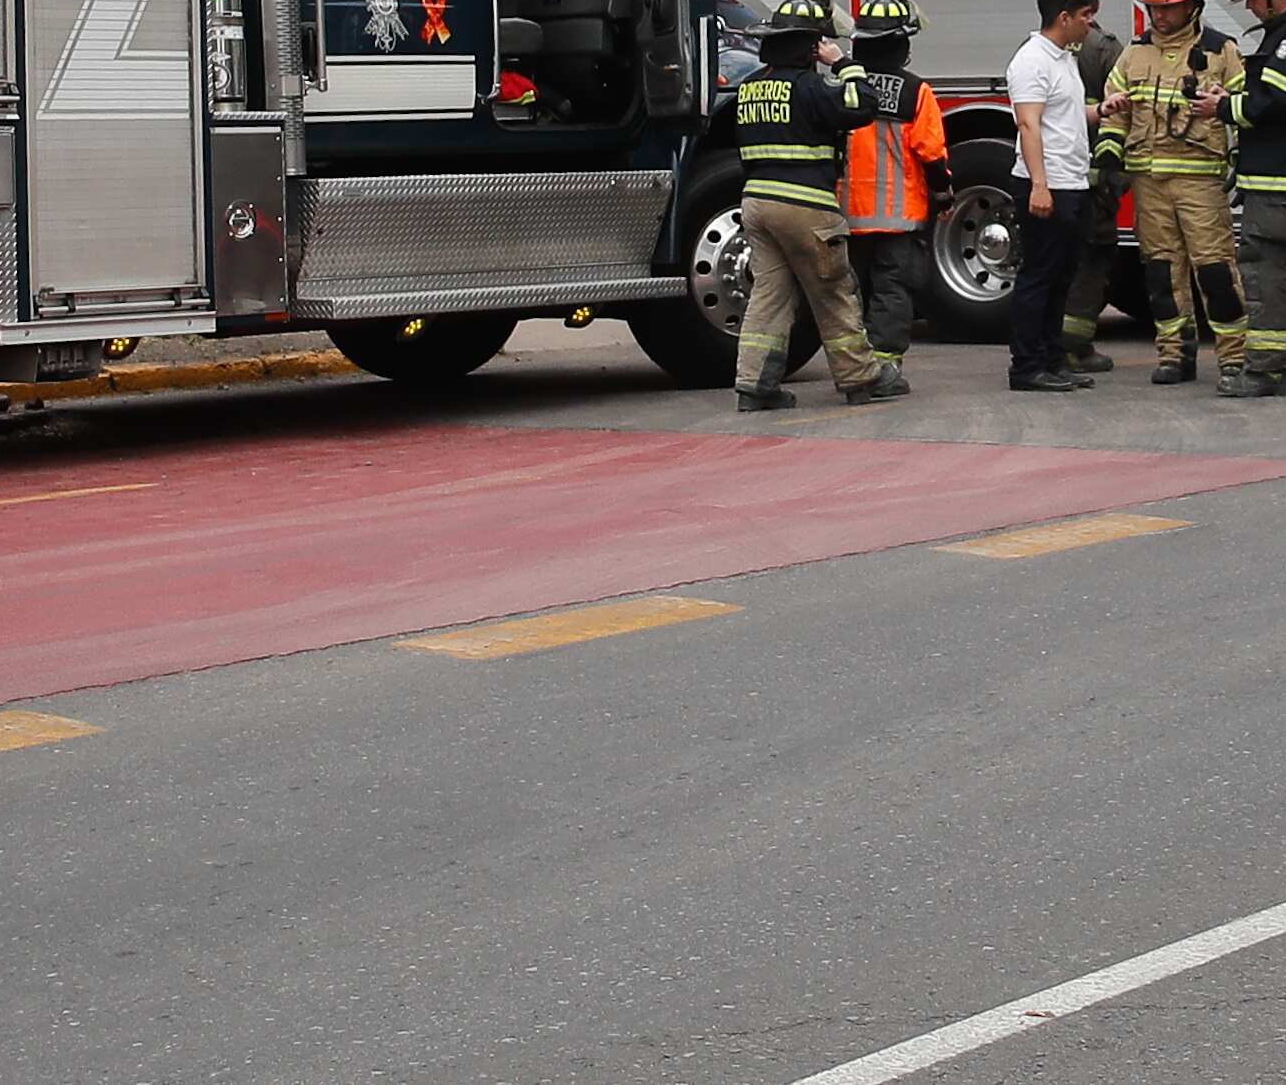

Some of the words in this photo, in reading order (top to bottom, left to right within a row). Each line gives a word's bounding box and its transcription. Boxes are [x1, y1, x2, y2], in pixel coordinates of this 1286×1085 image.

[738, 80, 792, 104] BOMBEROS
[867, 74, 902, 92] CATE
[737, 103, 791, 125] SANTIAGO
